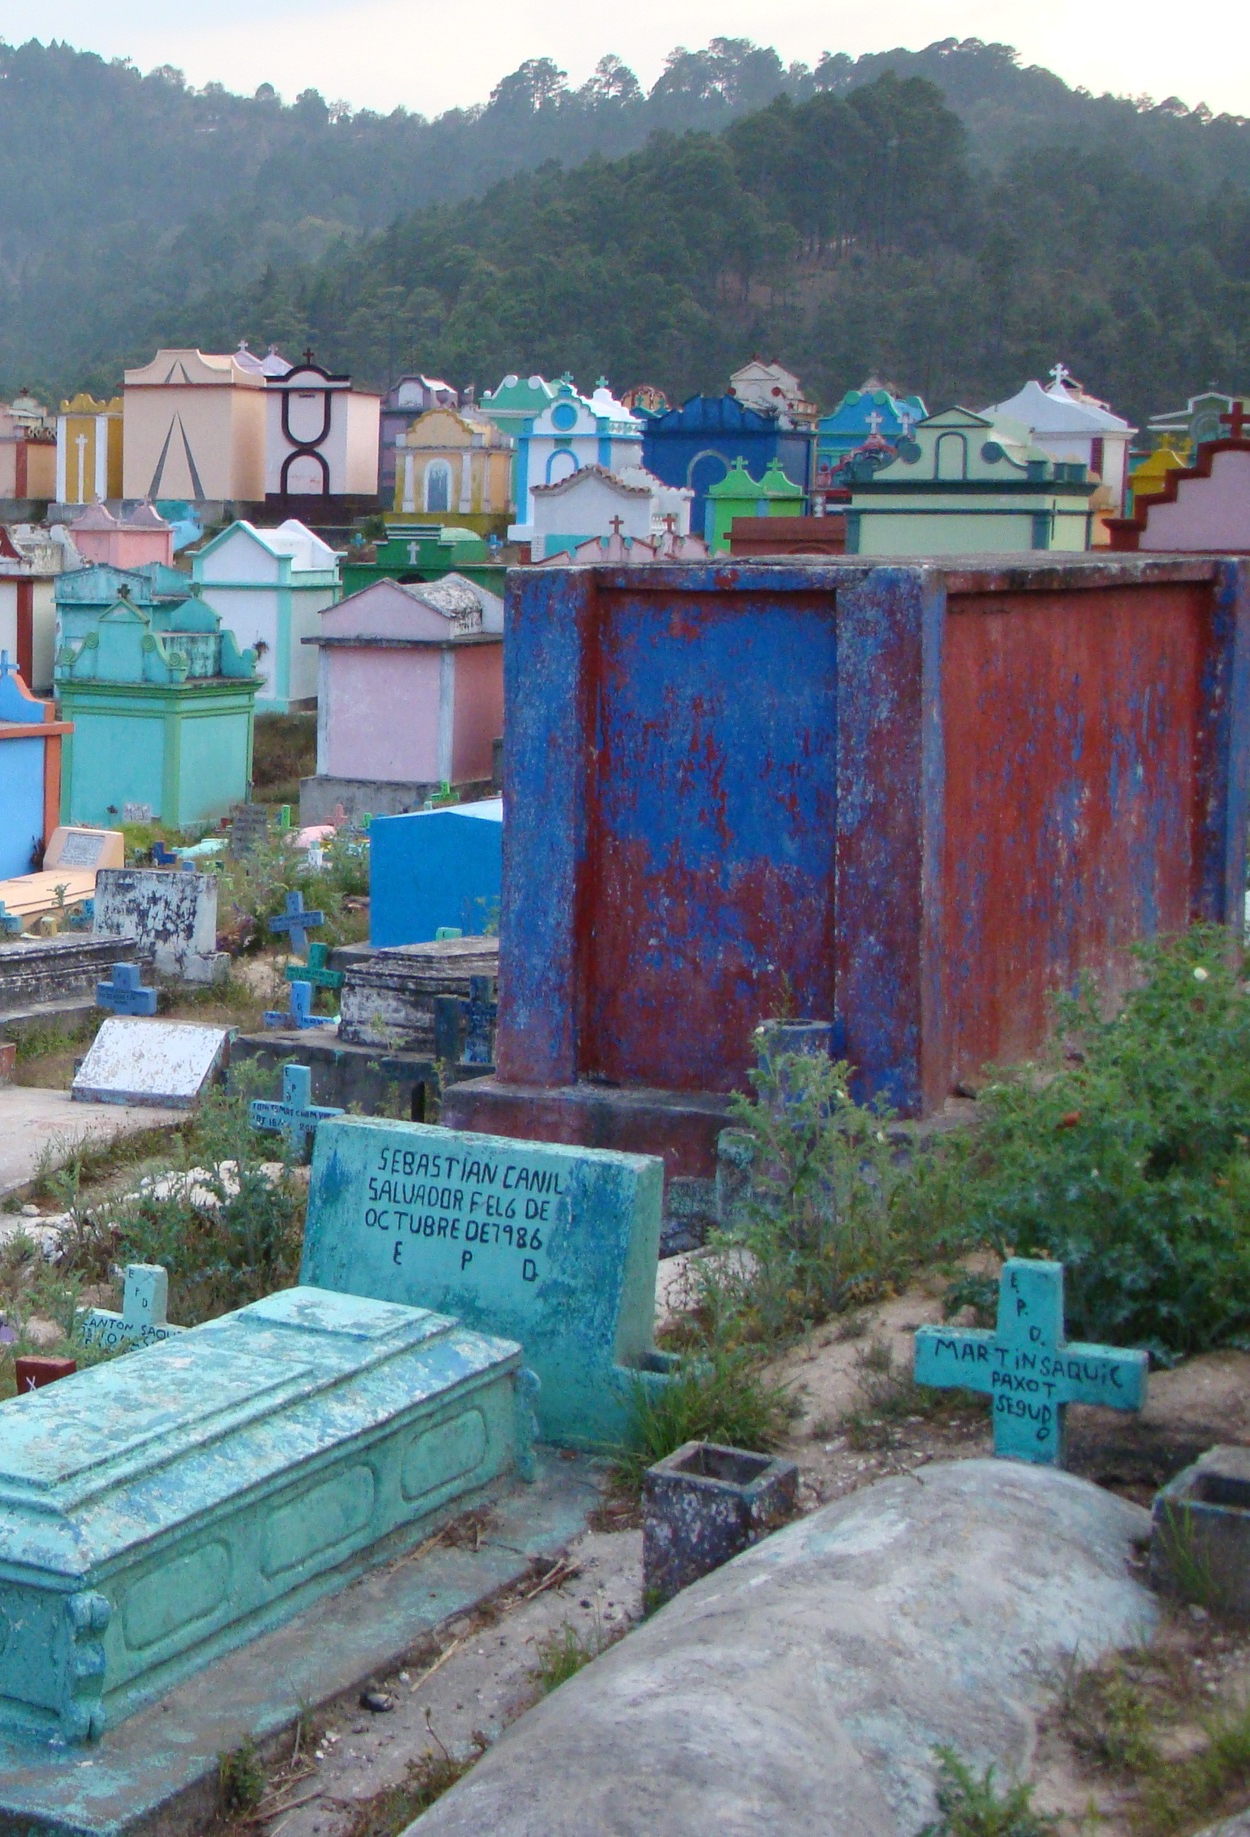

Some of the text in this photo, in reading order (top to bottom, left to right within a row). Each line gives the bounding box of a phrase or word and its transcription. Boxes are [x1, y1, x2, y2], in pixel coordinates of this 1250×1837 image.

[377, 1147, 564, 1195] SEBASTIAN CANIL
[368, 1177, 464, 1212] SALVADOR
[524, 1198, 551, 1221] DE
[364, 1208, 461, 1240] OCTUBRE
[392, 1241, 403, 1265] E
[460, 1250, 473, 1271] P
[992, 1370, 1057, 1398] PAXOT
